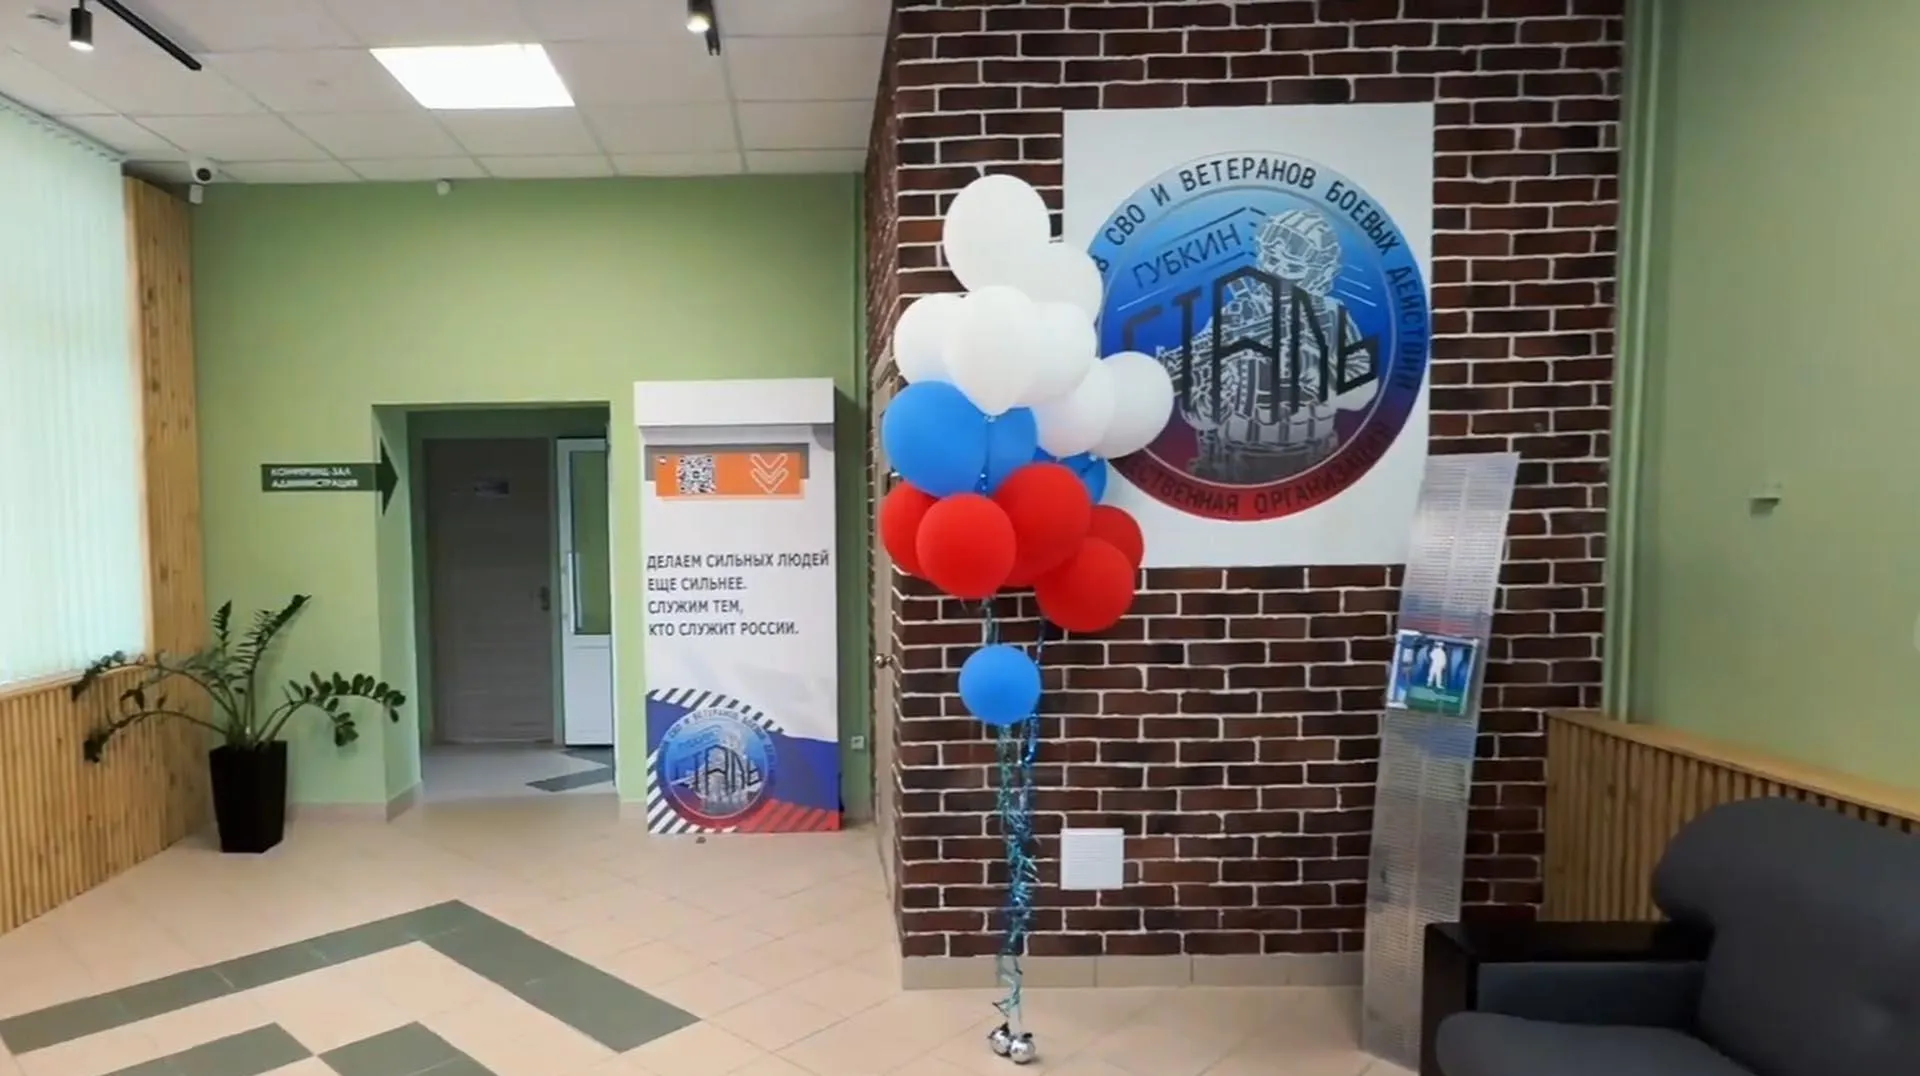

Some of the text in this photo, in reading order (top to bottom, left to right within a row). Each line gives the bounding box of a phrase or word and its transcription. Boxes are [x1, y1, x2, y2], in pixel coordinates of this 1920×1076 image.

[1105, 204, 1146, 246] СВО
[1151, 185, 1170, 206] И
[1179, 157, 1318, 193] ВЕТЕРАНОВ
[1326, 180, 1401, 254] БОЕВЫХ
[1131, 223, 1242, 289] ГУБКИН
[270, 478, 359, 489] АДСТРАЦИЯ
[1127, 458, 1239, 516] ЕСТВЕННАЯ
[646, 549, 829, 571] ДЕЛАЕМ СИЛЬНЫХ ЛЮДЕЙ
[647, 576, 747, 593] ЕЩЕ СИЛЬНЕЕ.
[647, 599, 744, 615] СЛУЖИМ ТЕМ,
[648, 621, 799, 636] КТО СЛУЖИТ РОССИИ.
